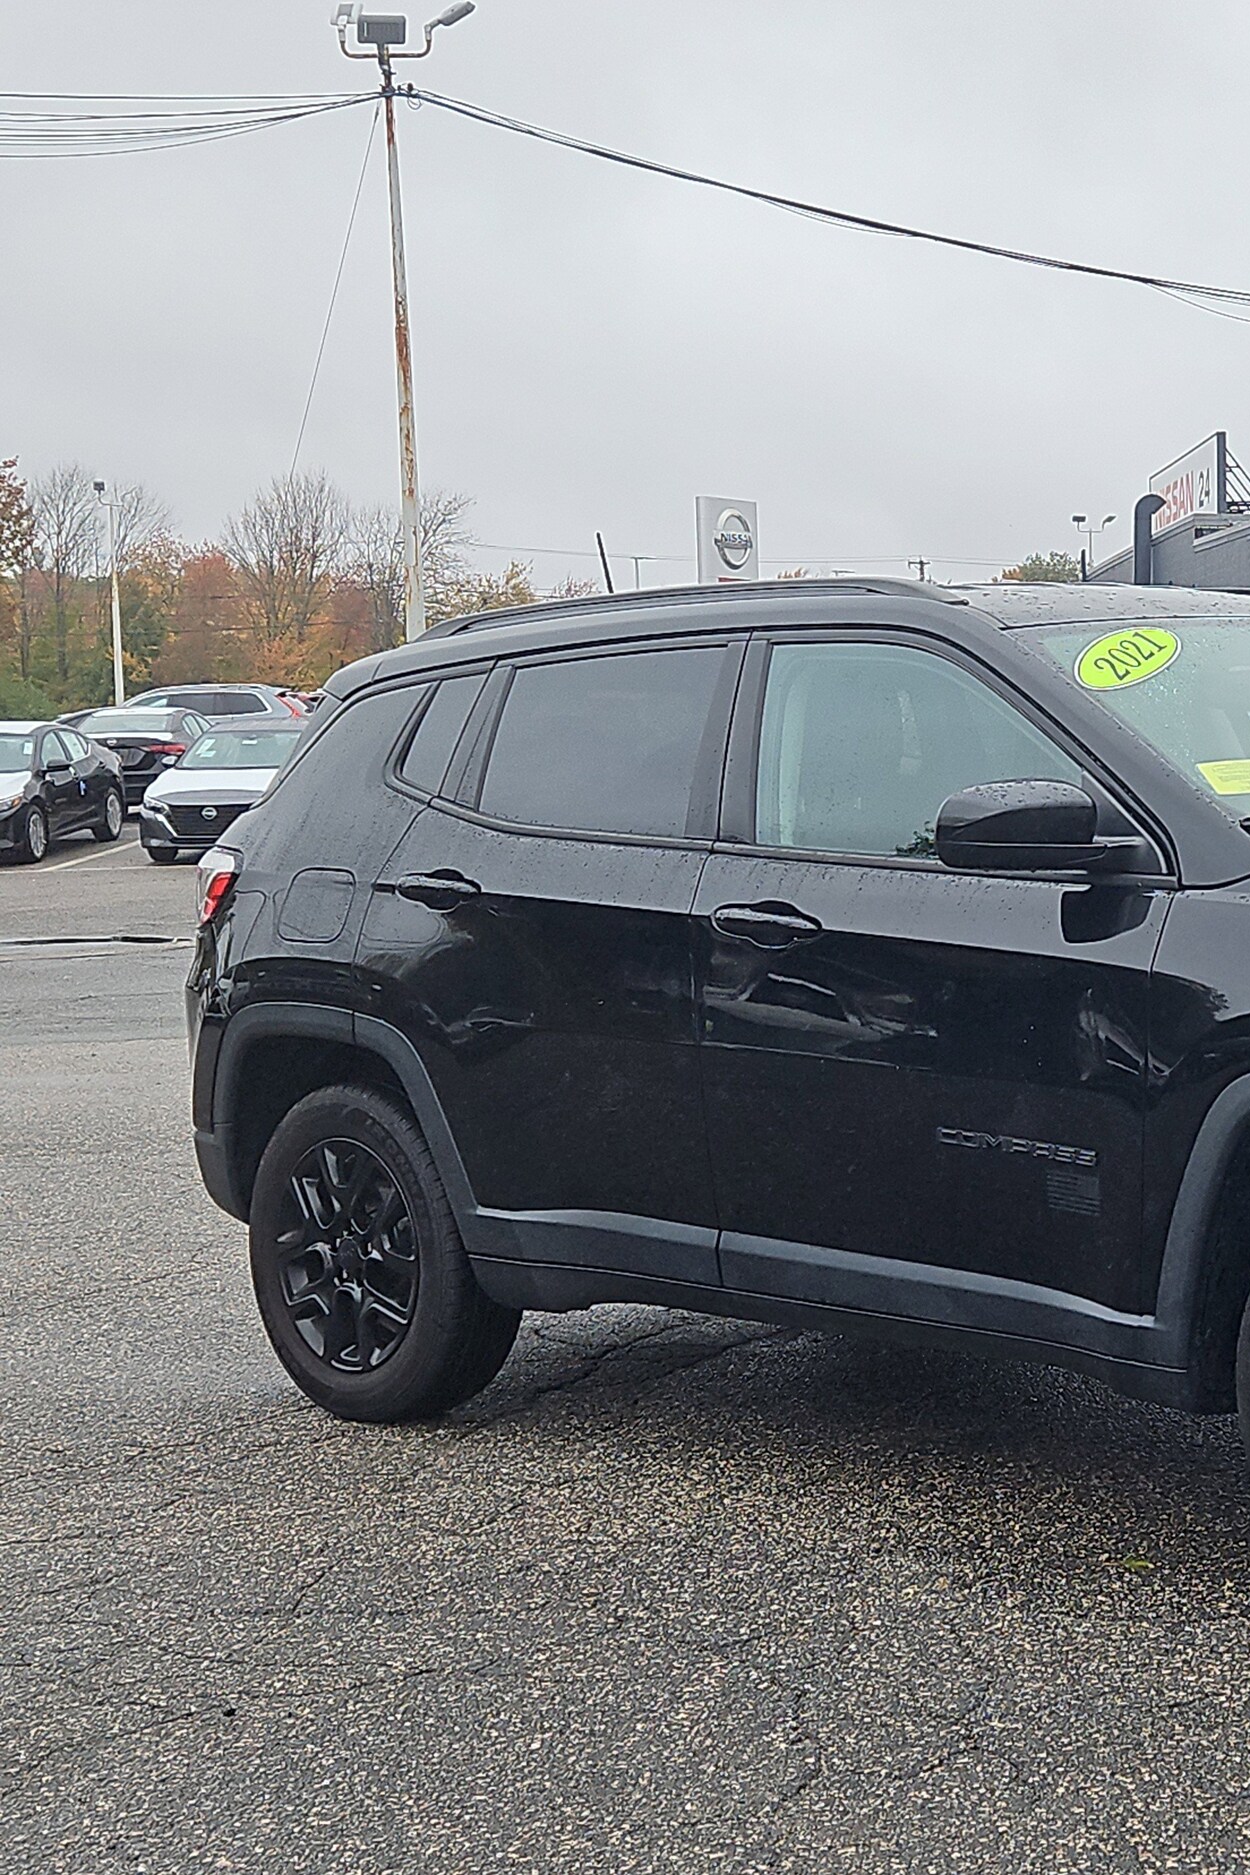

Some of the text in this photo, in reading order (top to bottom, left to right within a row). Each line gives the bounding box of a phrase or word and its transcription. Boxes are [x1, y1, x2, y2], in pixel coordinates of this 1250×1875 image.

[1198, 467, 1210, 509] 24
[1093, 631, 1168, 681] 2021
[937, 1126, 1097, 1167] COMPASS
